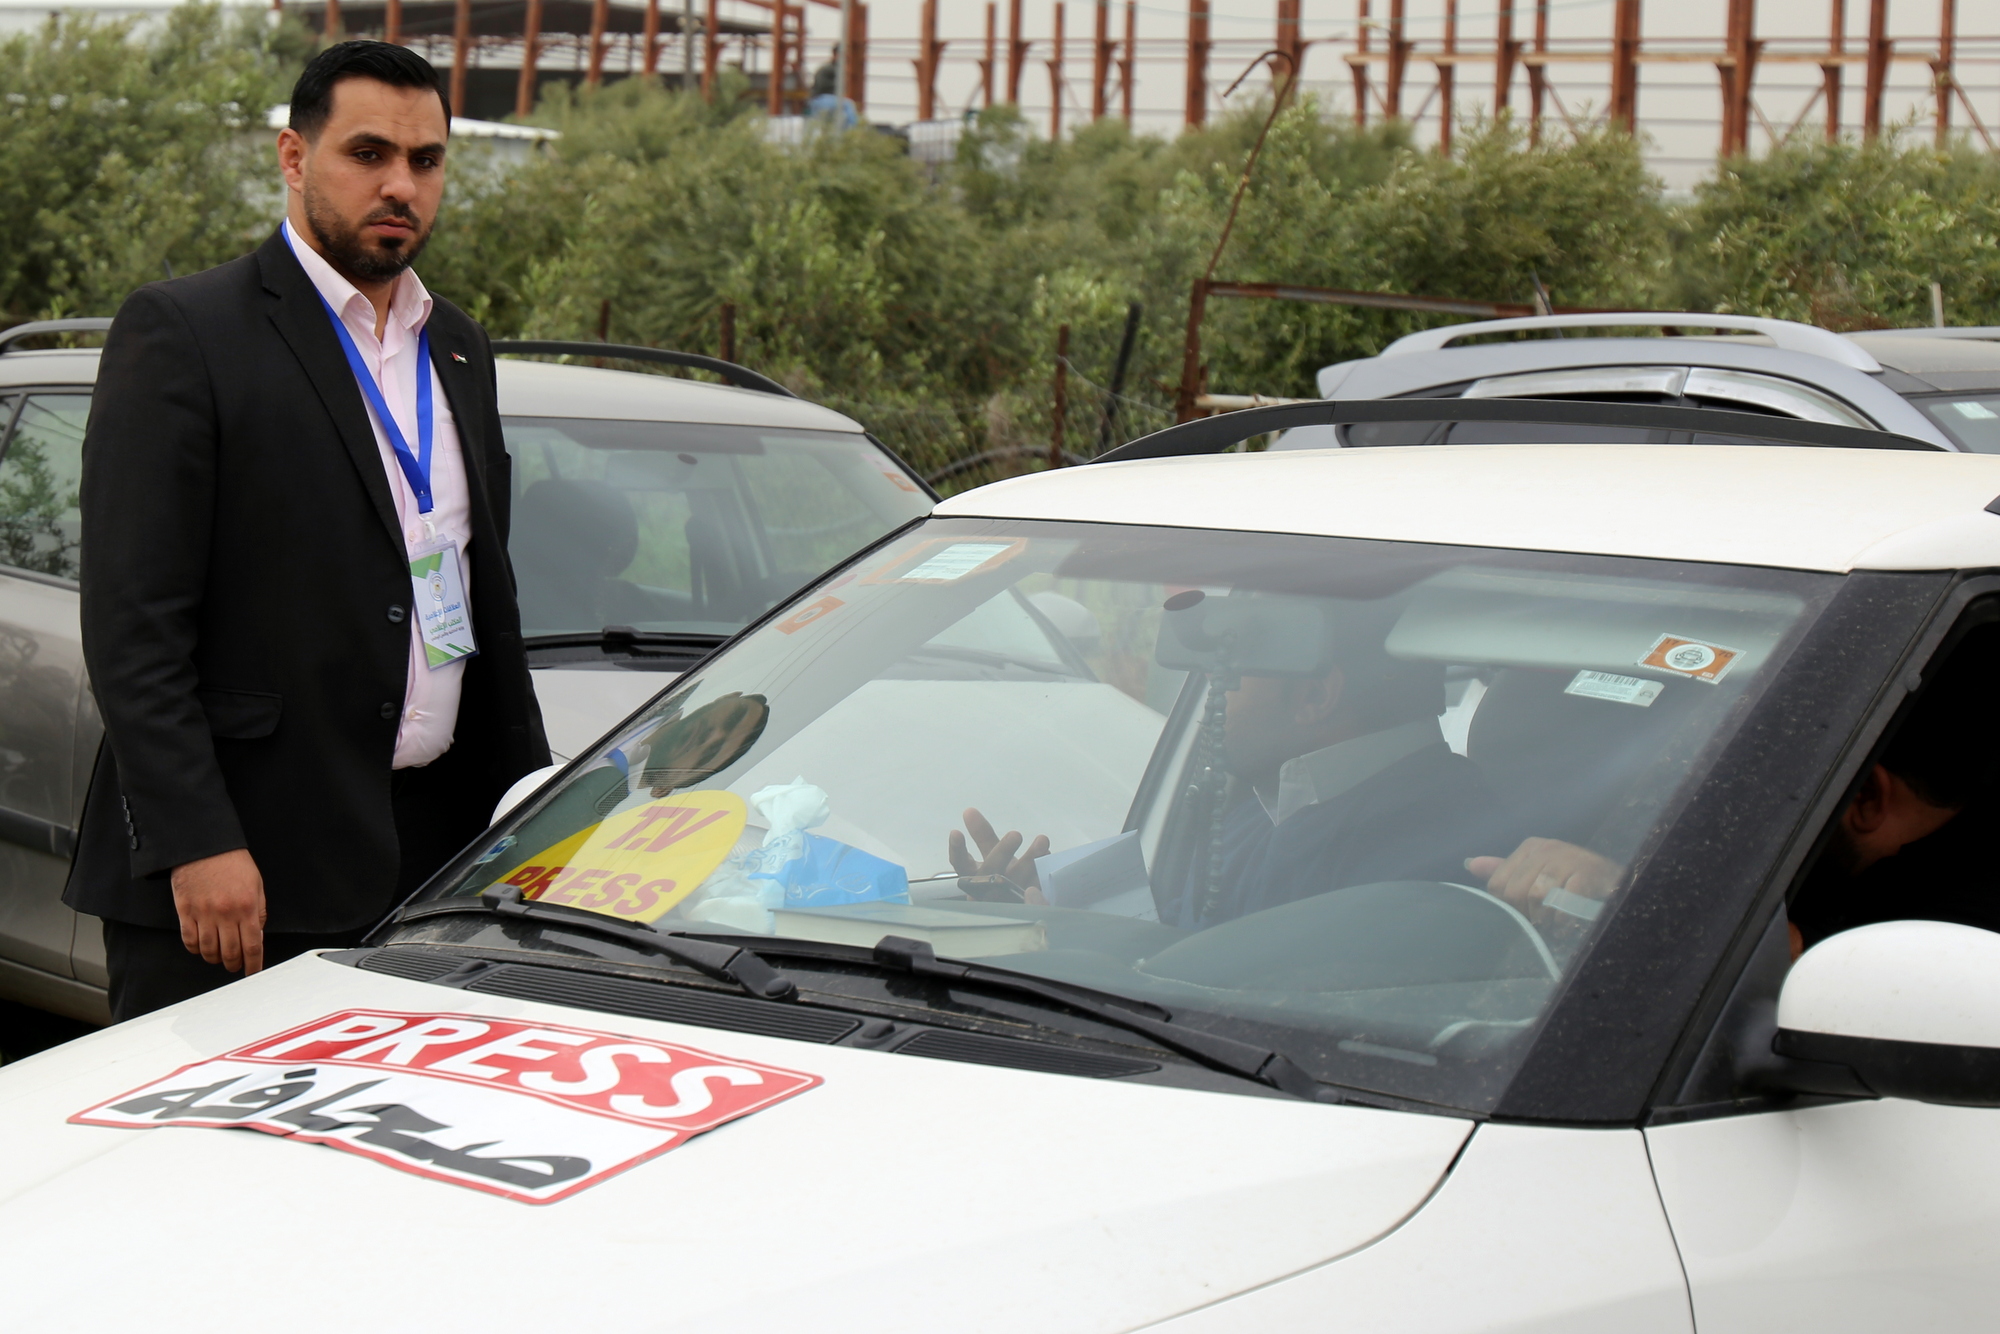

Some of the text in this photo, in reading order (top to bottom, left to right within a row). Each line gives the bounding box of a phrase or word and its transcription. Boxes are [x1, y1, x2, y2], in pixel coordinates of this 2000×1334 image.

[603, 805, 731, 853] T.V
[505, 866, 677, 915] PRESS
[252, 1015, 763, 1119] PRESS
